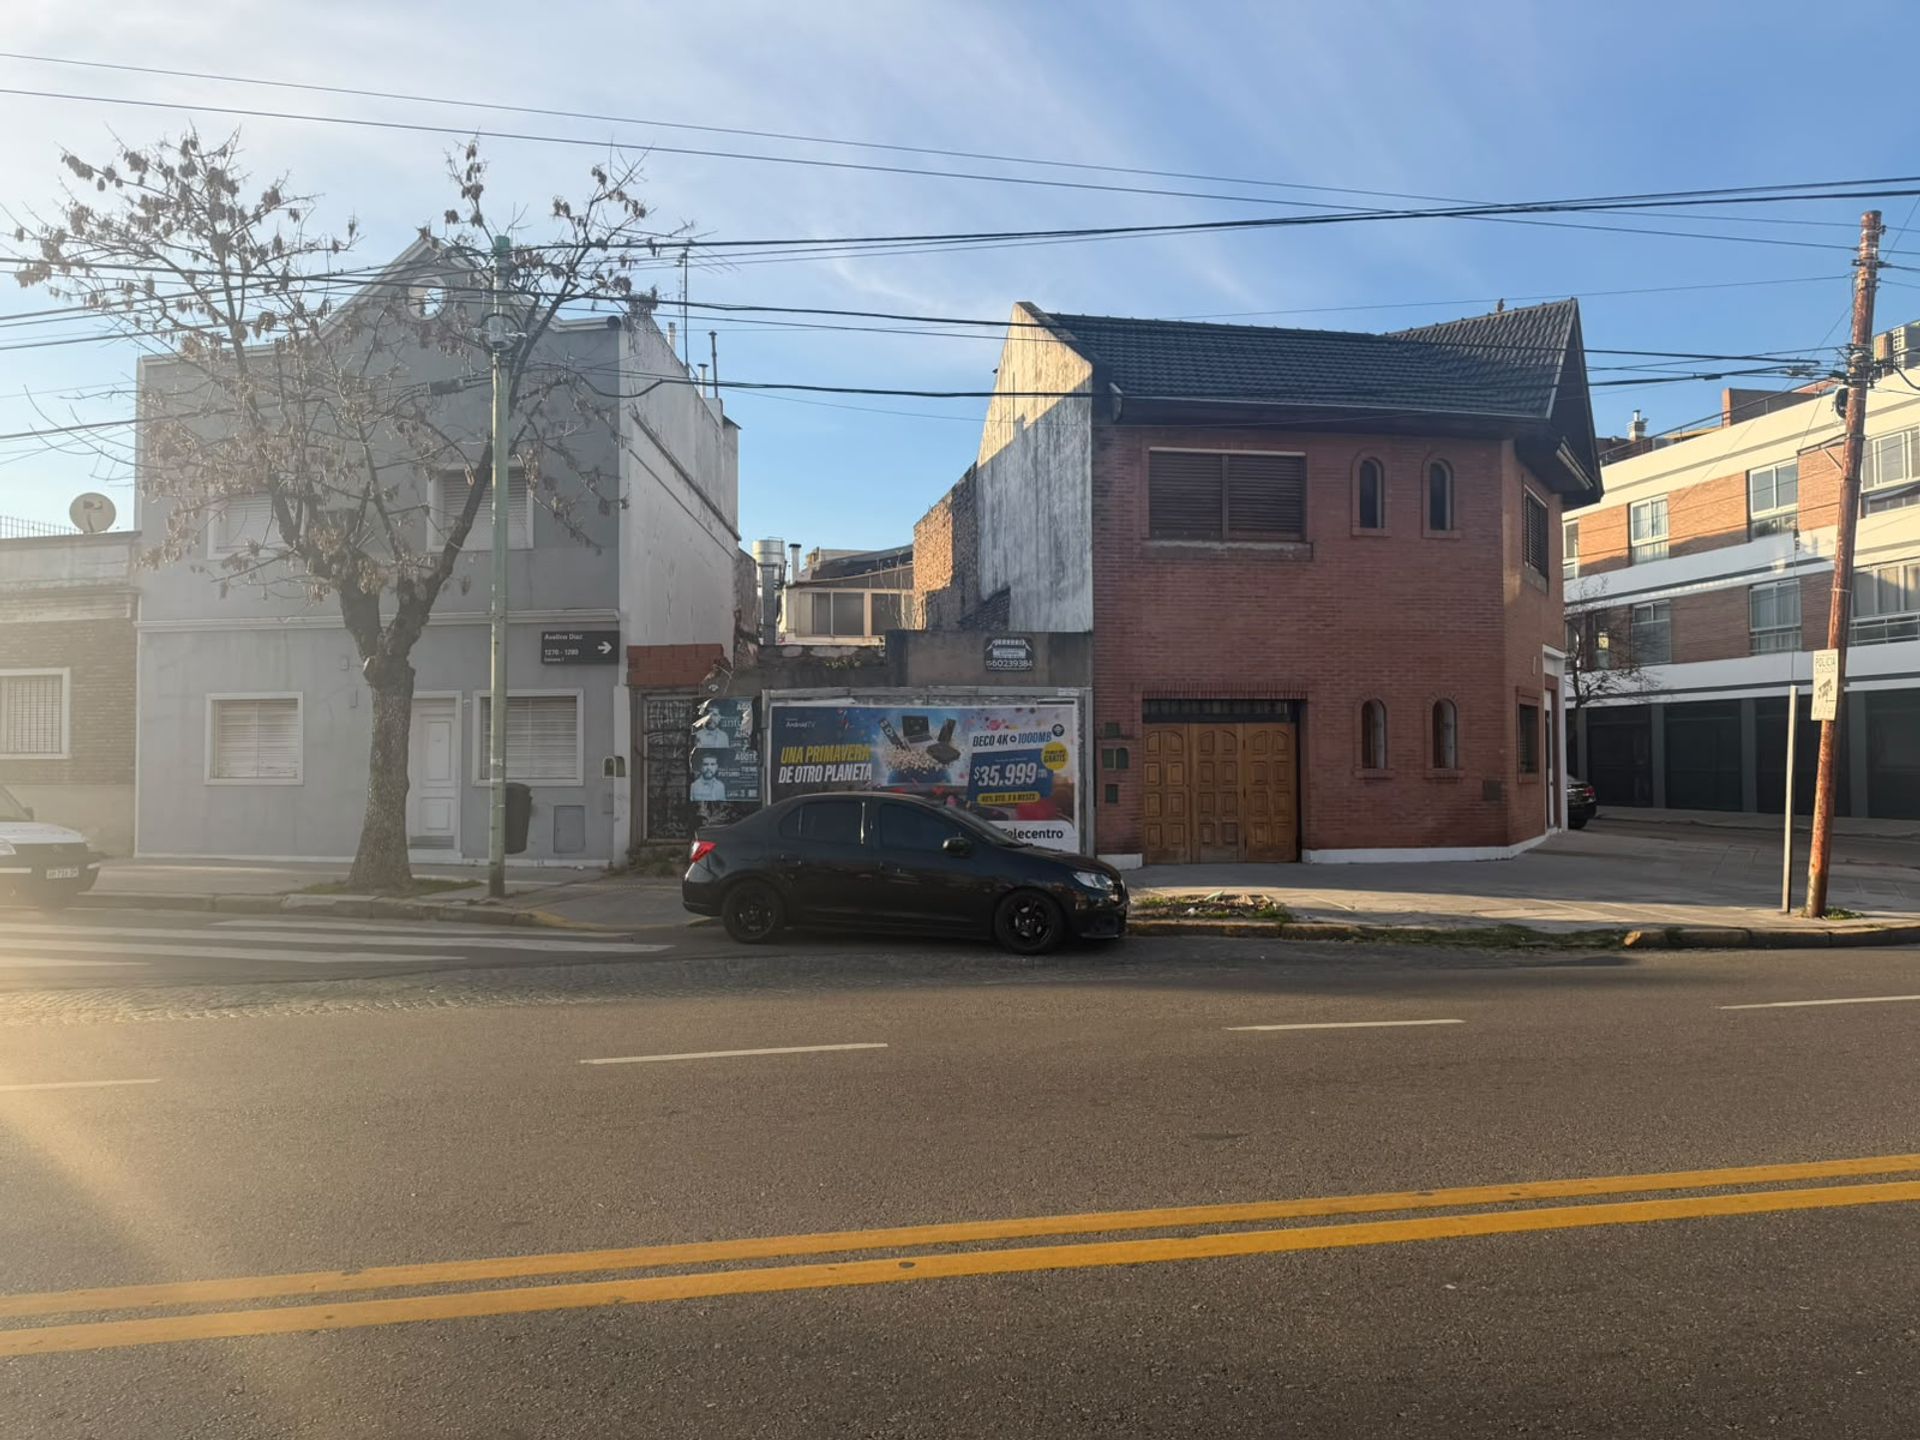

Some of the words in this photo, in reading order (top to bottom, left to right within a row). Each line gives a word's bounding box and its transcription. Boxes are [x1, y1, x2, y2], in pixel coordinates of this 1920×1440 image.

[973, 735, 995, 747] DECO
[996, 733, 1009, 746] 4K
[780, 746, 803, 764] UNA
[805, 744, 870, 763] PRIMAVERA
[778, 766, 794, 784] DE
[794, 765, 823, 783] OTRO
[824, 763, 872, 782] PLANETA
[974, 763, 1037, 787] $35.999
